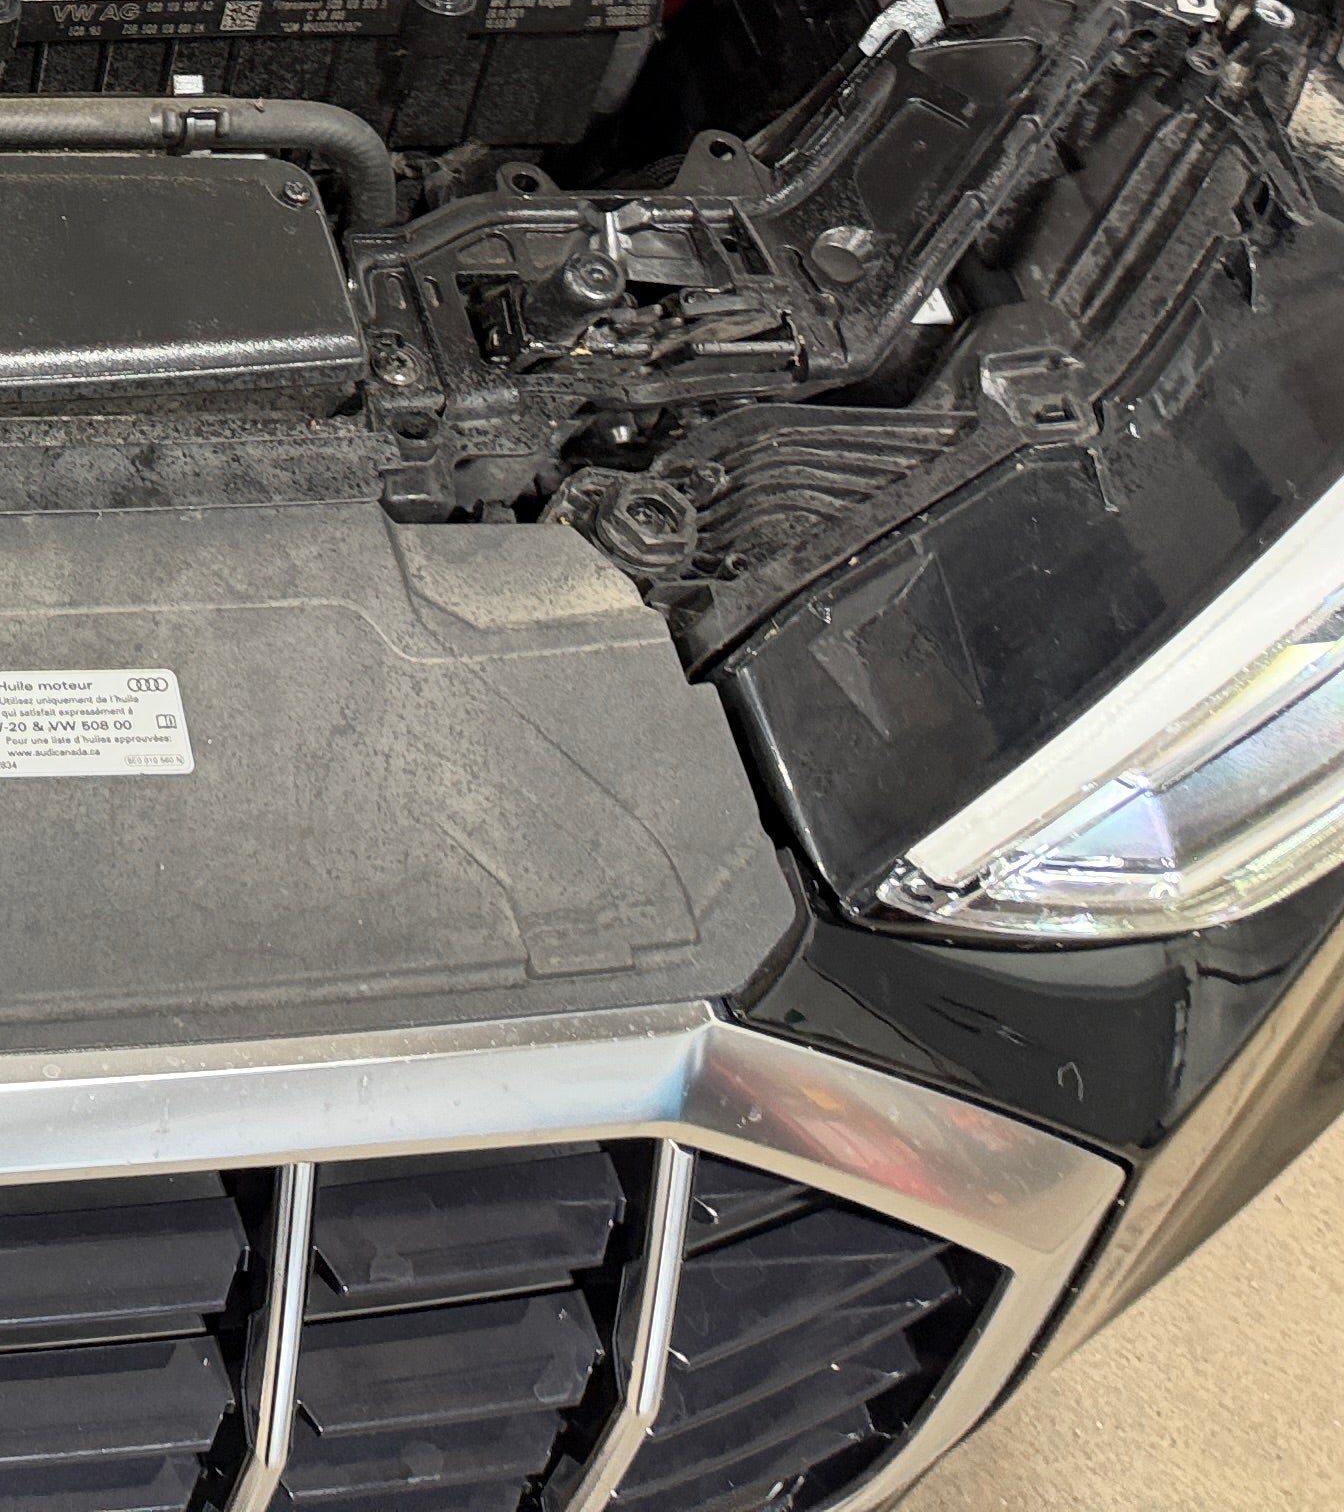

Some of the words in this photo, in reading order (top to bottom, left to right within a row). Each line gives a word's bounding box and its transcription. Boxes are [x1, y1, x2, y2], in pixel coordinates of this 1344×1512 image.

[52, 4, 97, 22] VW
[100, 3, 140, 20] AG
[38, 681, 92, 691] moteur
[36, 696, 92, 706] uniquement
[96, 696, 108, 704] de
[2, 708, 17, 718] qui
[20, 708, 56, 717] satisfait
[32, 722, 44, 732] &
[49, 721, 76, 732] VW
[82, 720, 109, 730] 508
[114, 720, 132, 730] 00
[6, 736, 28, 745] Pour
[30, 737, 48, 745] une
[51, 736, 70, 744] liste
[8, 748, 100, 758] www.audicanada.ca
